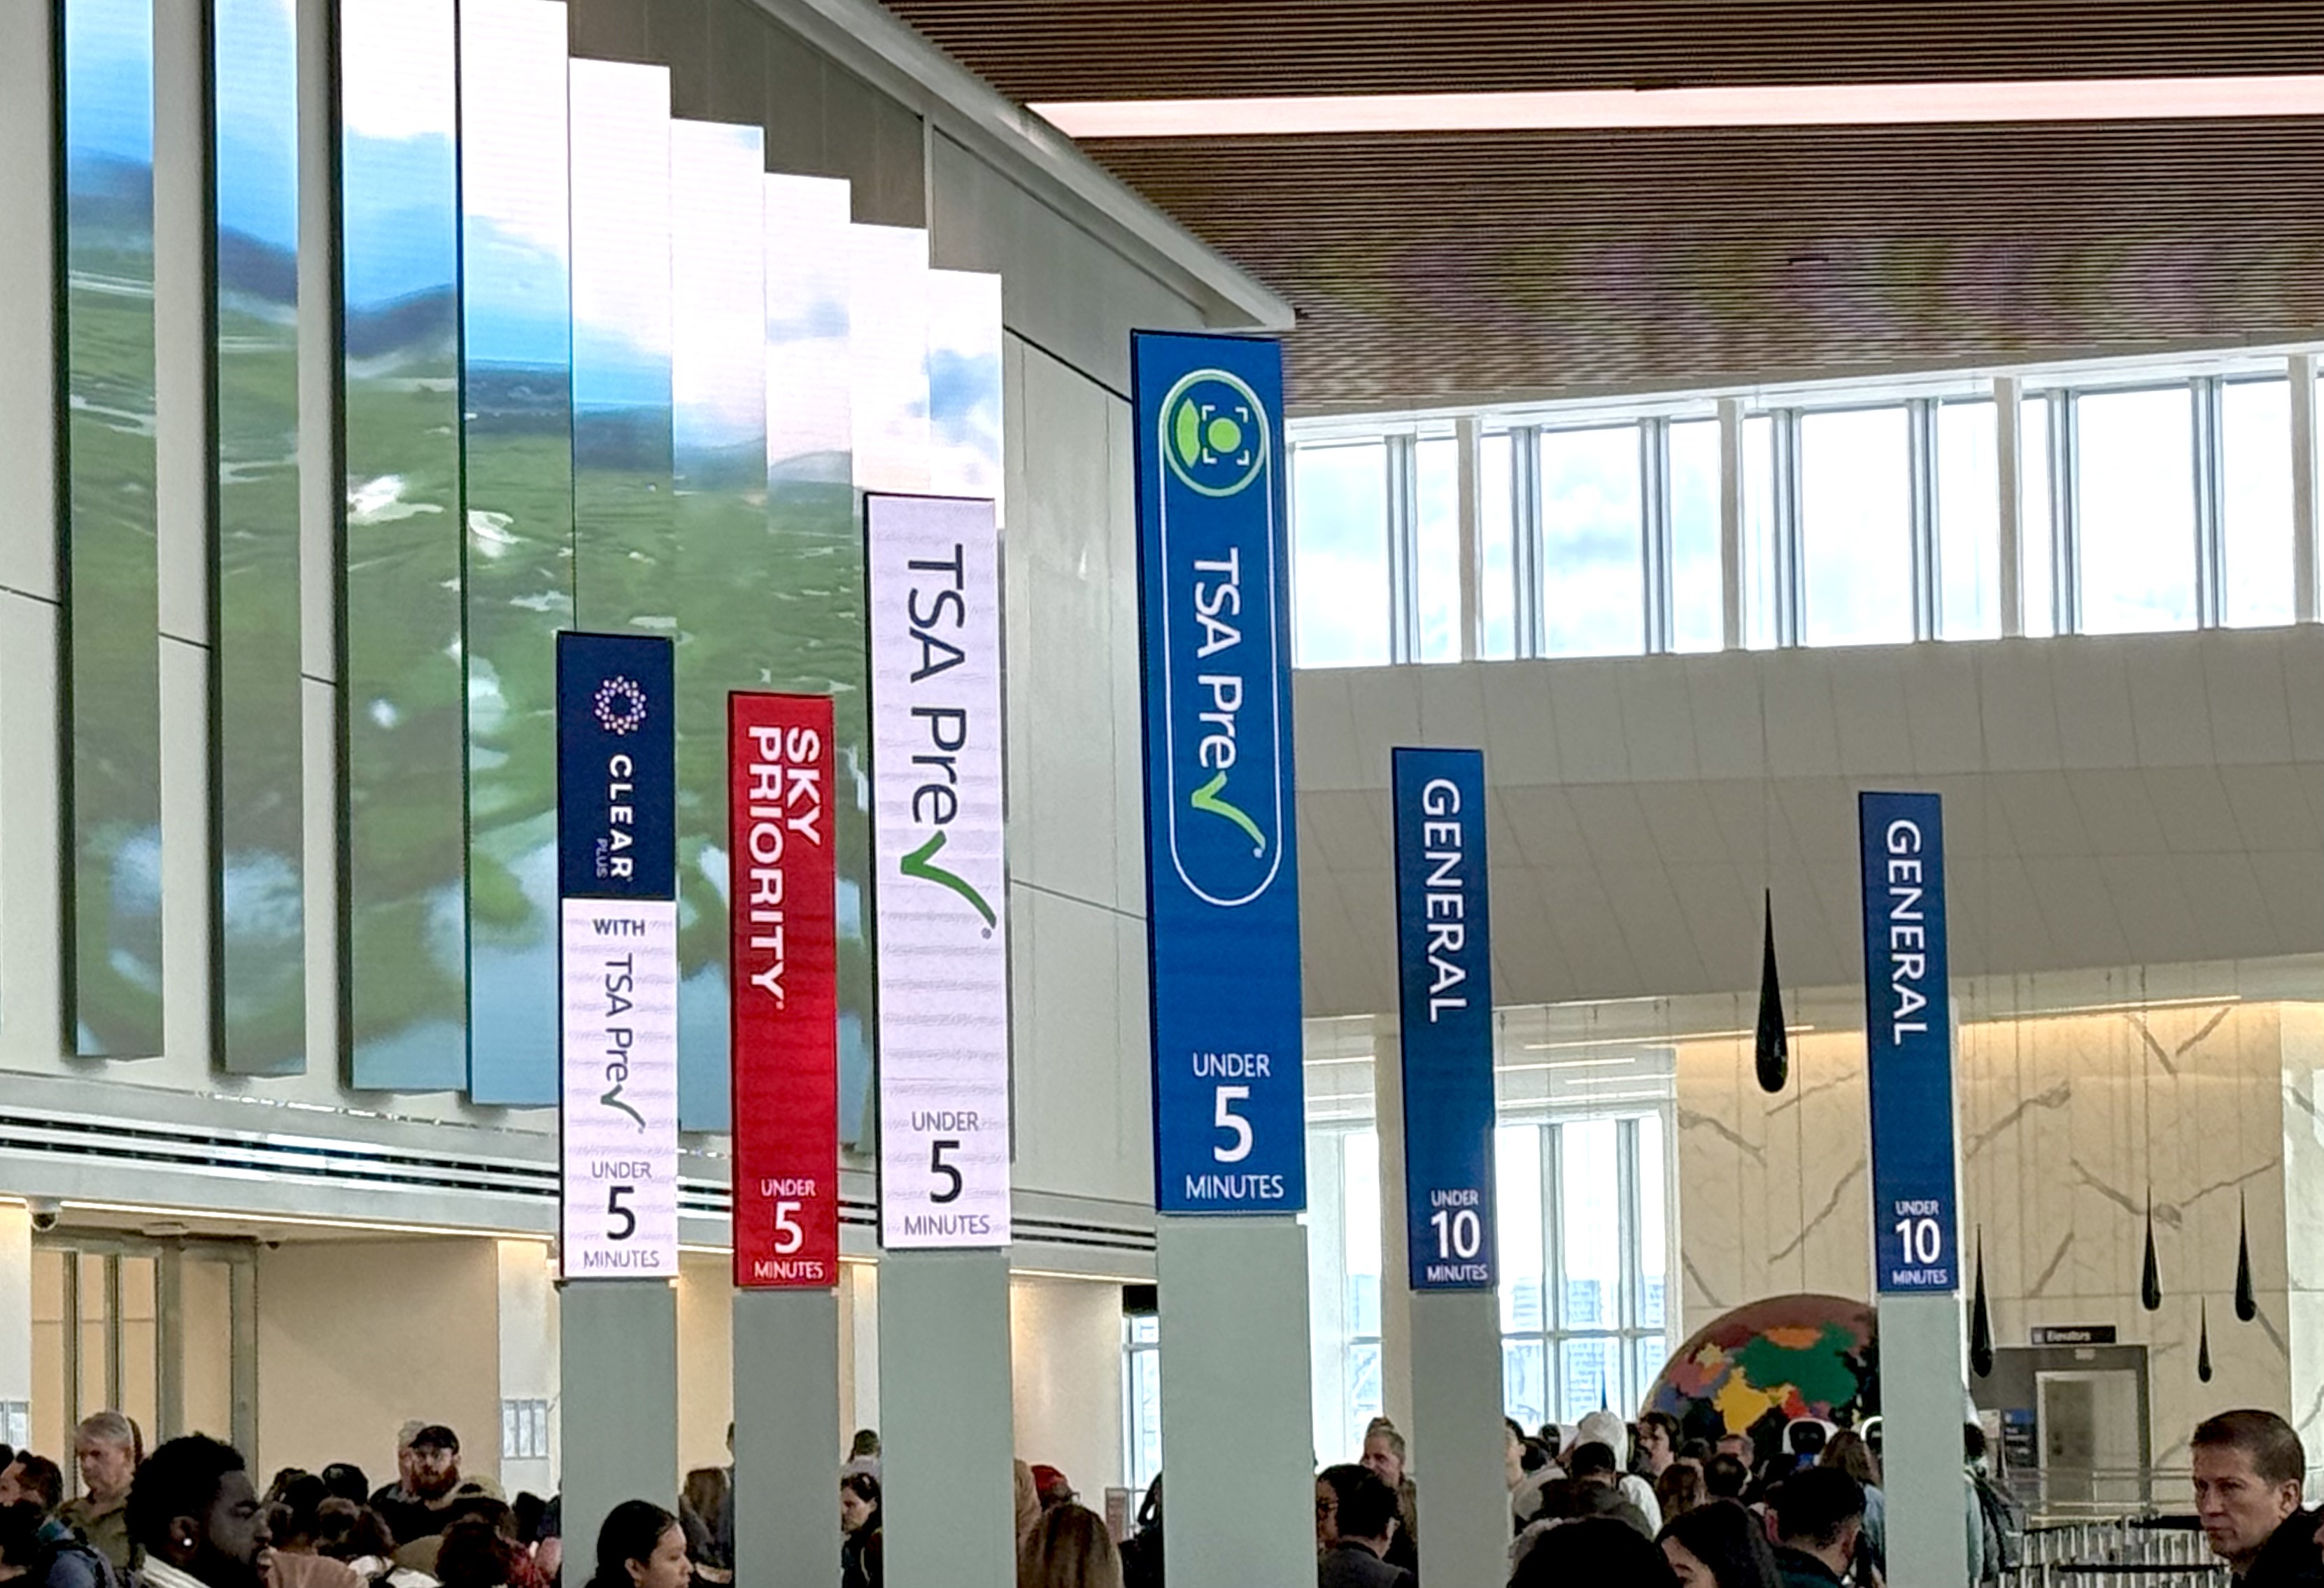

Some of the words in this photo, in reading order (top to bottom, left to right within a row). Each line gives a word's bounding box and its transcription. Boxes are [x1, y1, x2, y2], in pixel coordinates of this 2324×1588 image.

[907, 543, 965, 684] TSA
[1193, 547, 1242, 659] TSA
[786, 726, 821, 846] SKY
[609, 753, 633, 879] CLEAR
[596, 837, 608, 879] PLUS
[747, 725, 785, 1003] PRIORITY
[1422, 778, 1468, 1023] GENERAL
[593, 918, 646, 937] WITH
[1887, 819, 1928, 1046] GENERAL
[604, 952, 633, 1018] TSA
[1193, 1052, 1271, 1077] UNDER
[912, 1111, 979, 1132] UNDER
[1214, 1085, 1254, 1163] 5
[591, 1161, 652, 1179] UNDER
[760, 1179, 816, 1197] UNDER
[929, 1139, 963, 1204] 5
[1185, 1174, 1284, 1200] MINUTES
[607, 1185, 637, 1241] 5
[1431, 1190, 1480, 1207] UNDER
[1894, 1199, 1940, 1217] UNDER
[774, 1200, 803, 1254] 5
[904, 1214, 991, 1236] MINUTES
[1431, 1209, 1481, 1259] 10
[1895, 1217, 1941, 1265] 10
[583, 1249, 660, 1269] MINUTES
[753, 1261, 823, 1279] MINUTES
[1426, 1263, 1489, 1282] MINUTES
[1892, 1268, 1948, 1286] MINUTES
